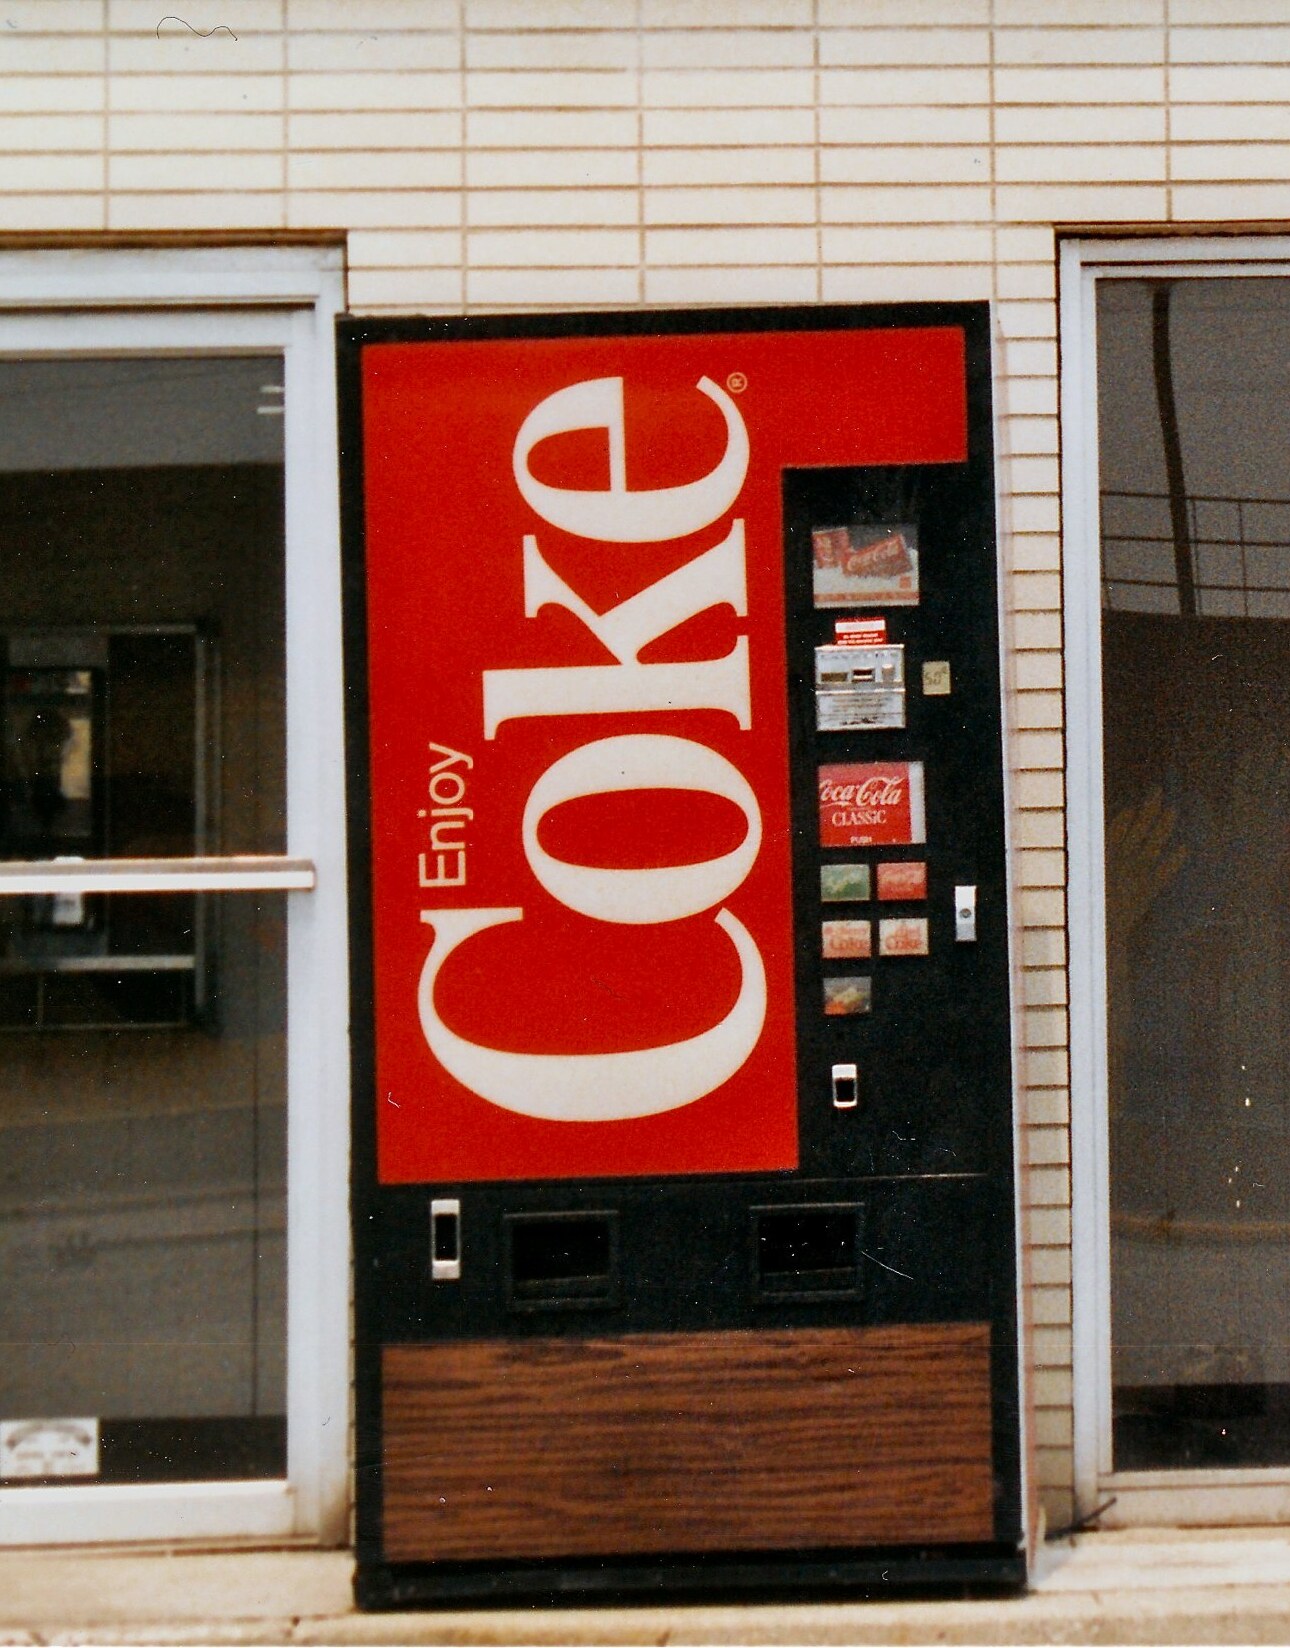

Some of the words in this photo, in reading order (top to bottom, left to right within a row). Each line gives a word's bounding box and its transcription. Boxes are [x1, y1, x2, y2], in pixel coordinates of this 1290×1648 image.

[417, 375, 767, 1122] Coke
[418, 742, 473, 888] Enjoy
[831, 810, 887, 827] CLASSIC
